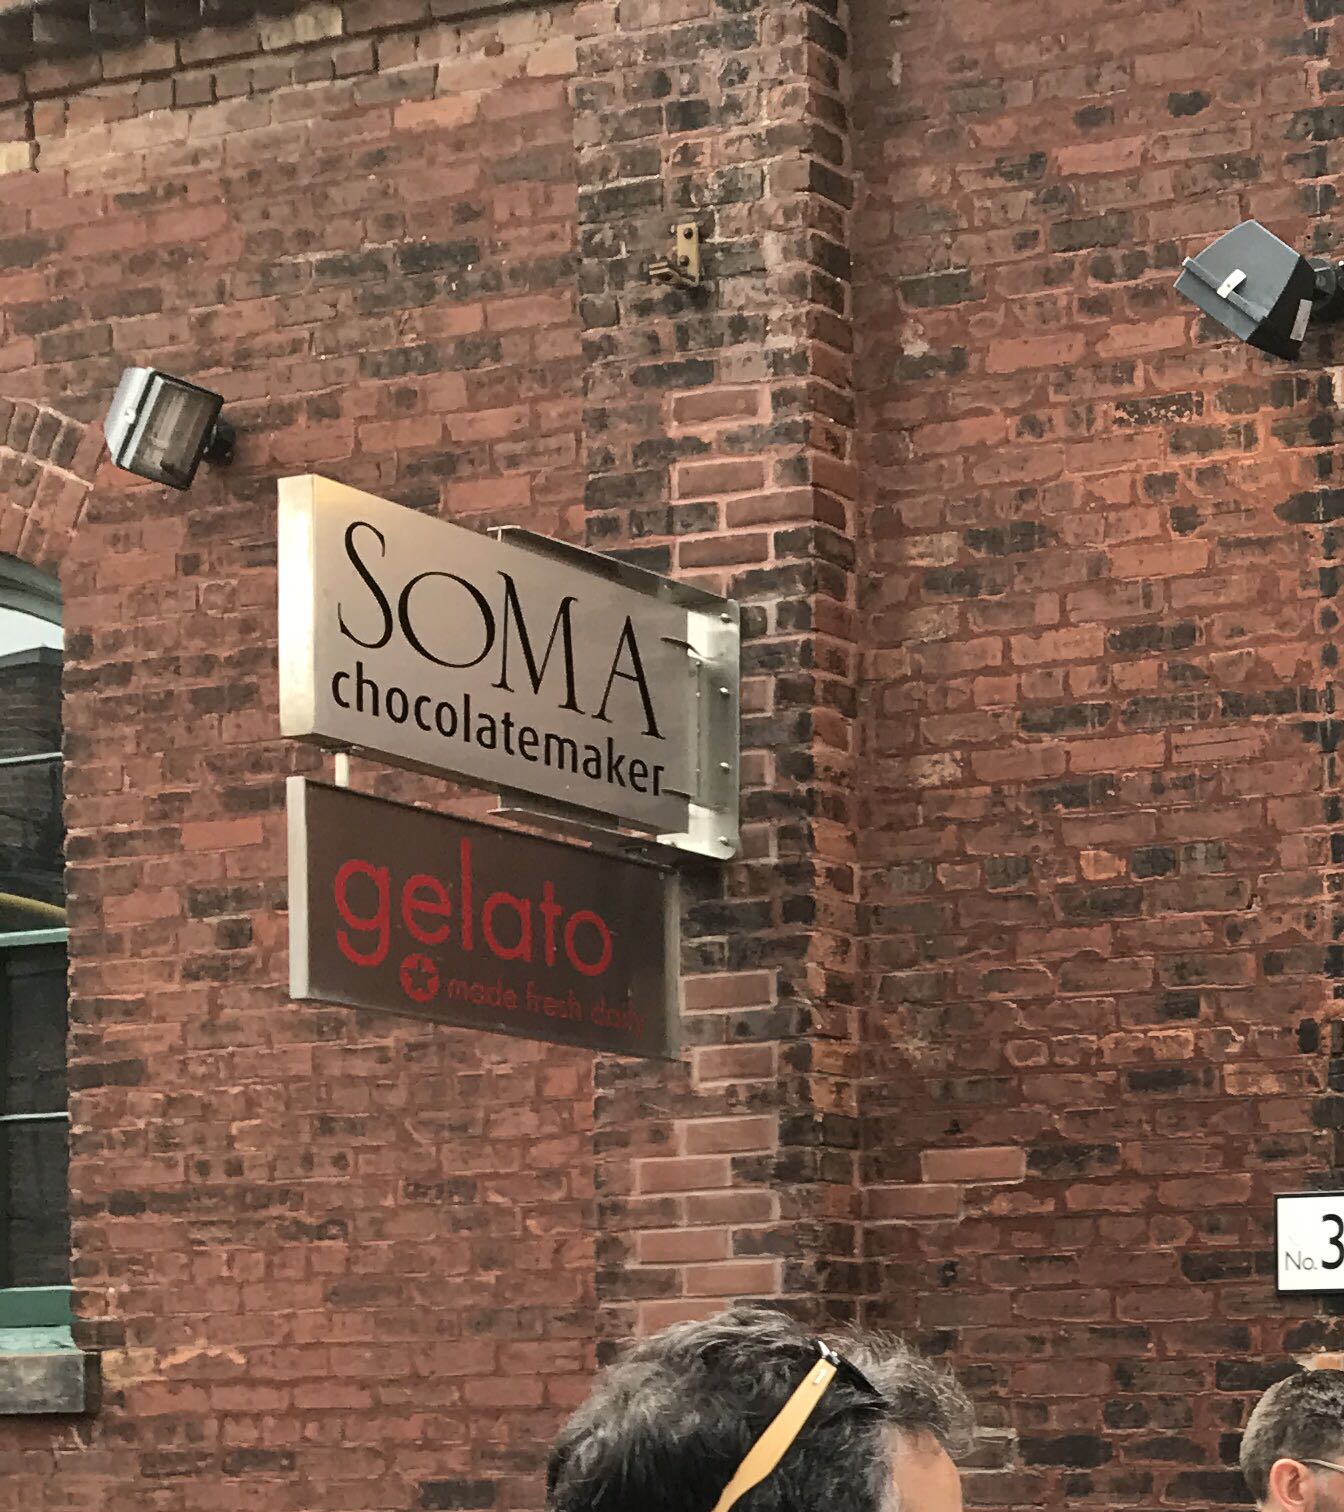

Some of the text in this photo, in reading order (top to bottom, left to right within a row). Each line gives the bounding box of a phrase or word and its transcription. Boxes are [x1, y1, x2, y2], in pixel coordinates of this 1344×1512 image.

[338, 521, 666, 740] SOMA
[331, 661, 665, 796] chocolatemaker
[334, 837, 613, 977] gelato
[447, 976, 519, 1010] made
[526, 980, 582, 1021] fresh
[1284, 1250, 1318, 1271] No.
